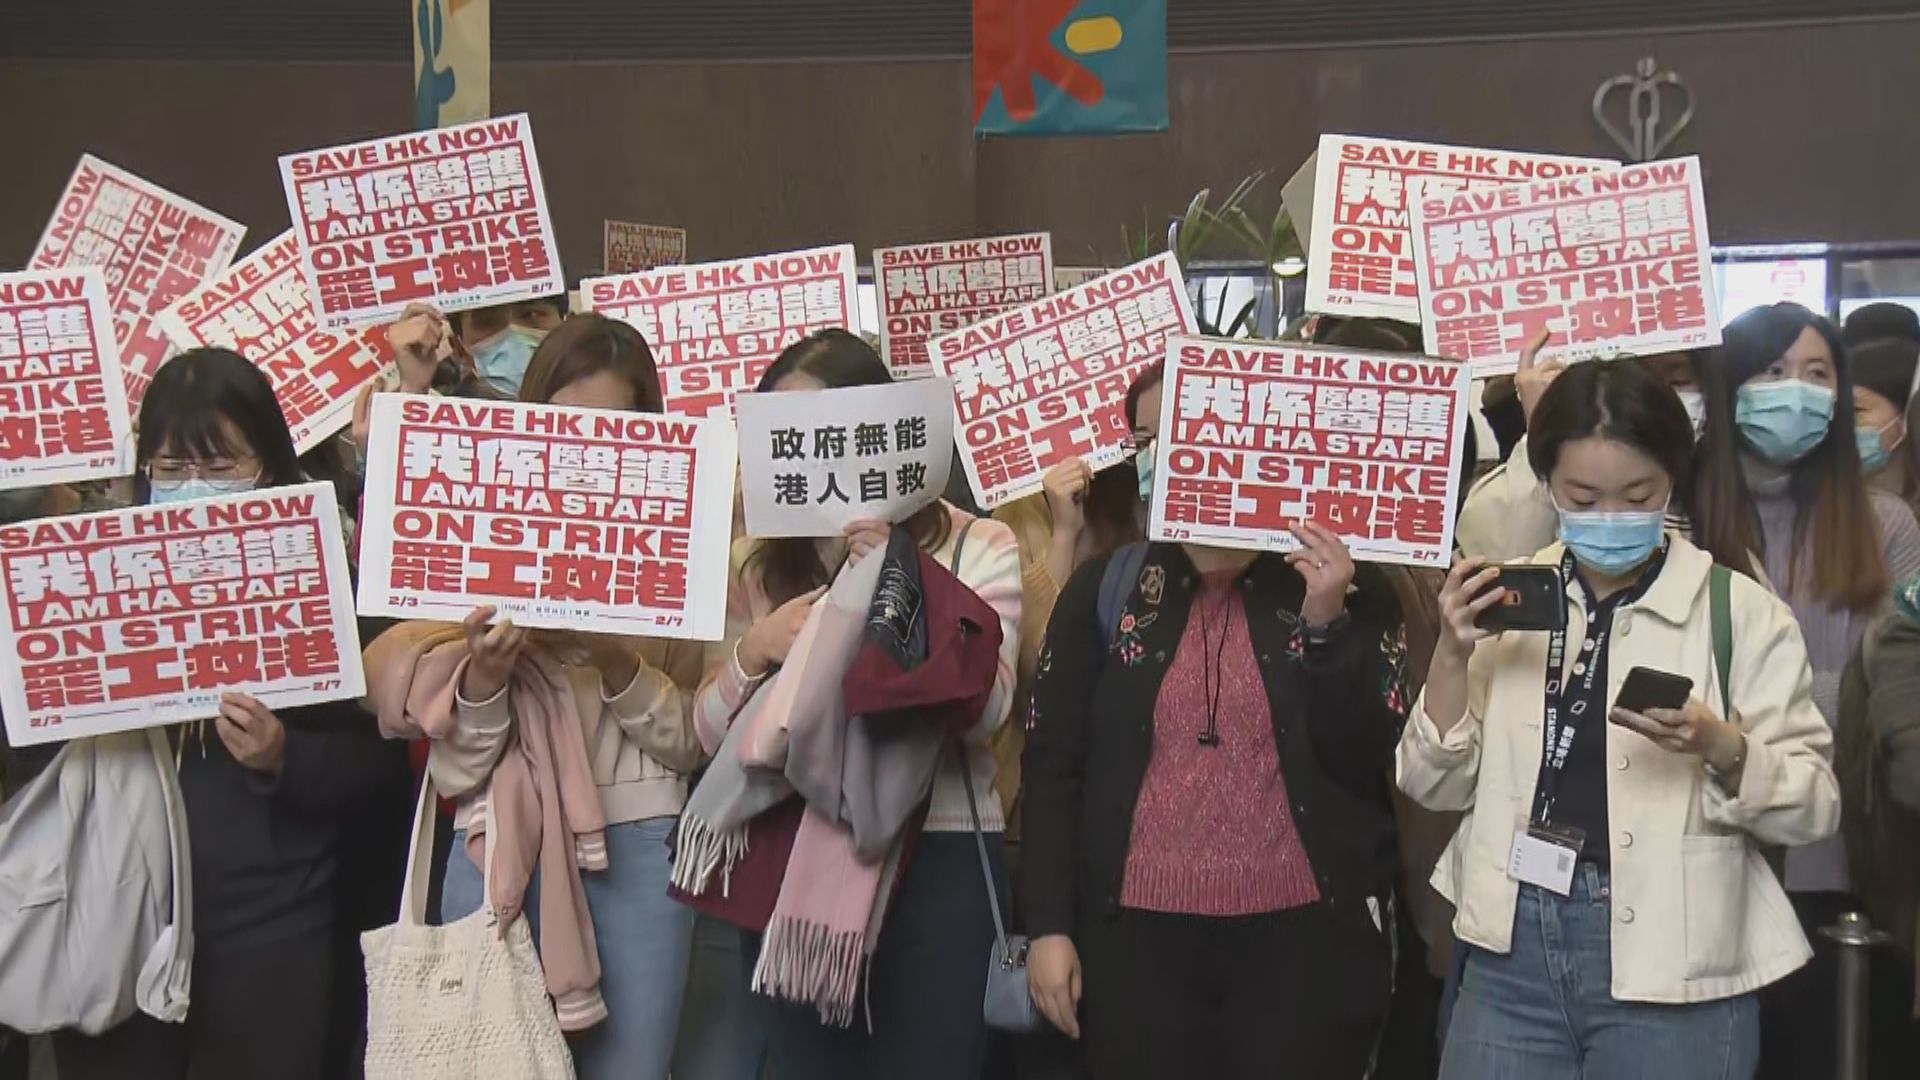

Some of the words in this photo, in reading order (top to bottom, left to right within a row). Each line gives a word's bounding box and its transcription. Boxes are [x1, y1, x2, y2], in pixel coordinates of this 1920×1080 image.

[291, 145, 379, 177] SAVE
[384, 136, 431, 161] HK
[437, 120, 520, 151] NOW
[1341, 143, 1438, 169] SAVE
[1447, 154, 1499, 174] HK
[1507, 160, 1600, 179] NO
[299, 145, 527, 223] 我係醫護
[1422, 188, 1520, 220] SAVE
[1529, 179, 1582, 204] HK
[1591, 163, 1688, 195] NOW
[33, 244, 57, 271] K
[52, 166, 98, 241] NOW
[67, 179, 140, 267] 醫護
[309, 224, 319, 241] I
[324, 214, 374, 239] AM
[380, 205, 426, 229] HA
[430, 187, 530, 221] STAFF
[1340, 202, 1349, 222] I
[1357, 206, 1408, 228] AM
[1428, 189, 1690, 266] 我係醫護
[105, 195, 159, 287] STAFF
[310, 239, 374, 271] ON
[382, 211, 541, 259] STRIKE
[882, 247, 946, 265] SAVE
[951, 243, 983, 258] HK
[988, 238, 1042, 255] NOW
[1331, 228, 1402, 255] ON
[1434, 267, 1443, 285] I
[1450, 258, 1506, 283] AM
[1515, 250, 1566, 274] HA
[1574, 233, 1690, 266] STAFF
[114, 202, 187, 345] STRIKE
[177, 262, 263, 322] SAVE
[315, 236, 551, 313] 罷工救港
[529, 282, 553, 293] 2/7
[592, 274, 687, 302] SAVE
[696, 264, 745, 289] HK
[754, 252, 841, 281] NOW
[886, 255, 1043, 299] 我係醫護
[889, 300, 895, 312] I
[900, 295, 936, 311] AM
[942, 291, 973, 306] HA
[978, 283, 1043, 302] STAFF
[1431, 284, 1502, 316] ON
[1513, 258, 1699, 305] STRIKE
[197, 264, 314, 350] 我係
[886, 313, 933, 335] ON
[939, 310, 1030, 358] SAVE
[1034, 291, 1082, 323] HK
[1087, 260, 1169, 304] NOW
[1327, 295, 1353, 305] 2/3
[1434, 284, 1705, 359] 罷工救港
[244, 326, 293, 362] AM
[292, 310, 317, 335] H
[681, 337, 730, 361] HA
[737, 323, 842, 352] STA
[949, 284, 1179, 401] 我係醫護
[0, 352, 94, 381] TAFF
[264, 348, 306, 386] N
[681, 358, 774, 392] STR
[962, 401, 973, 419] I
[977, 380, 1029, 413] AM
[1034, 361, 1081, 392] HA
[1084, 331, 1165, 374] STAF
[1179, 346, 1284, 374] SAVE
[1293, 354, 1349, 378] HK
[1359, 359, 1458, 387] NOW
[0, 378, 106, 413] RIKE
[1178, 373, 1451, 440] 我係醫護
[0, 406, 114, 461] 救港
[402, 400, 514, 430] SAVE
[524, 410, 582, 435] HK
[593, 415, 697, 444] NOW
[770, 416, 927, 461] 政府無能
[963, 405, 1031, 449] ON
[973, 399, 1129, 490] 罷工救
[1177, 421, 1186, 440] I
[1195, 422, 1255, 446] AM
[1264, 428, 1318, 451] HA
[1326, 433, 1445, 461] STAFF
[402, 430, 691, 500] 我係醫護
[774, 461, 927, 505] 港人自救
[1168, 448, 1244, 479] ON
[1256, 455, 1448, 496] STRIKE
[0, 515, 122, 549] SAVE
[131, 507, 196, 534] HK
[206, 494, 317, 526] NOW
[402, 481, 411, 501] I
[421, 482, 484, 507] AM
[495, 488, 551, 512] HA
[560, 493, 685, 523] STAFF
[1164, 476, 1445, 544] 罷工救港
[393, 509, 473, 542] ON
[488, 517, 689, 559] STRIKE
[1162, 527, 1190, 539] 2/3
[1412, 549, 1440, 560] 2/7
[7, 523, 320, 604] 我係醫護
[389, 540, 687, 610] 罷工救港
[17, 605, 29, 626] I
[38, 596, 109, 623] AM
[119, 588, 181, 614] HA
[189, 572, 321, 606] STAFF
[388, 594, 418, 607] 2/3
[654, 615, 682, 627] 2/7
[14, 625, 105, 662] ON
[118, 599, 332, 649] STRIKE
[20, 627, 339, 711] 罷工救港
[311, 679, 341, 691] 2/7
[29, 714, 62, 727] 2/3
